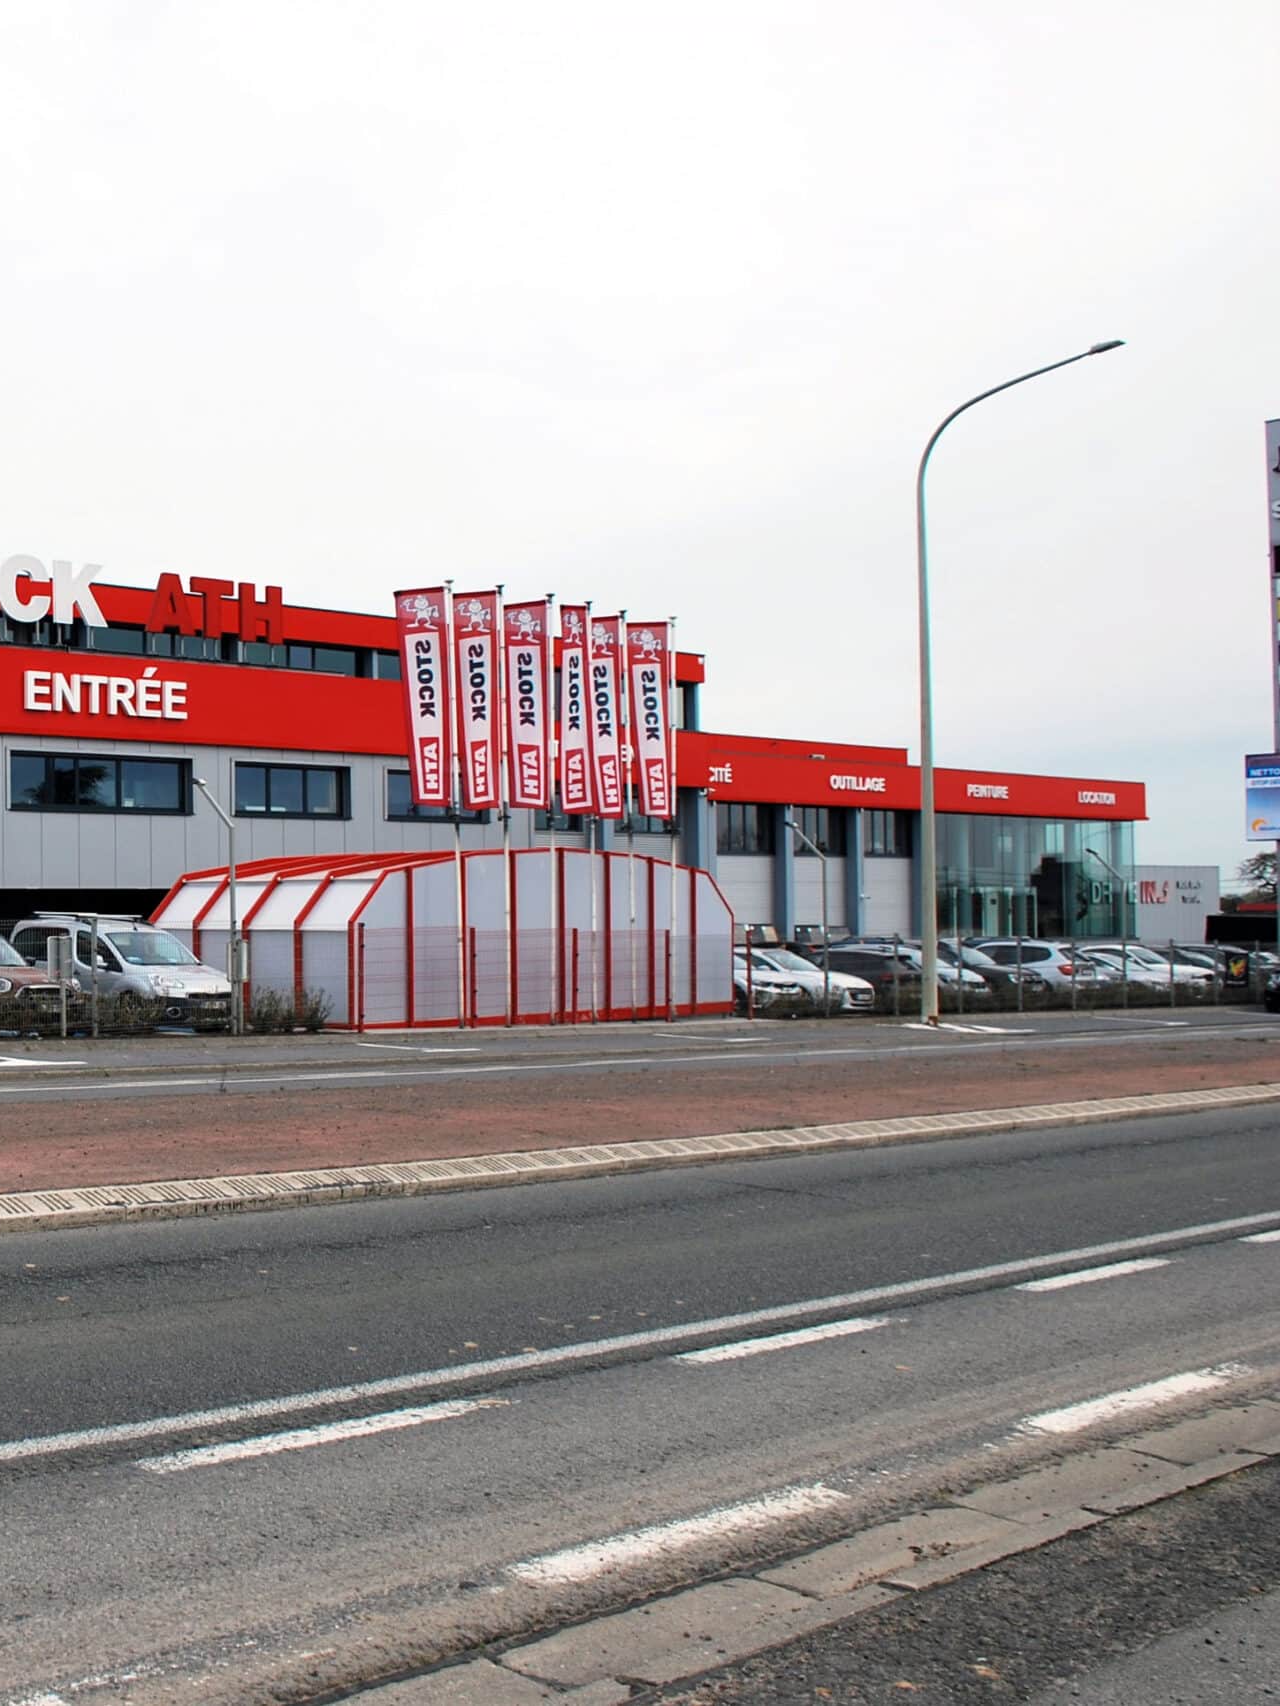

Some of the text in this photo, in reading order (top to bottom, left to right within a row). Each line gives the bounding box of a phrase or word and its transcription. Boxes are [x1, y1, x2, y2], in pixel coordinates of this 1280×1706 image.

[145, 571, 283, 645] ATH
[23, 667, 188, 720] ENTRÉE
[830, 774, 886, 792] OUTILLAGE
[966, 784, 1009, 800] PEINTURE
[1077, 791, 1116, 806] LOCATION
